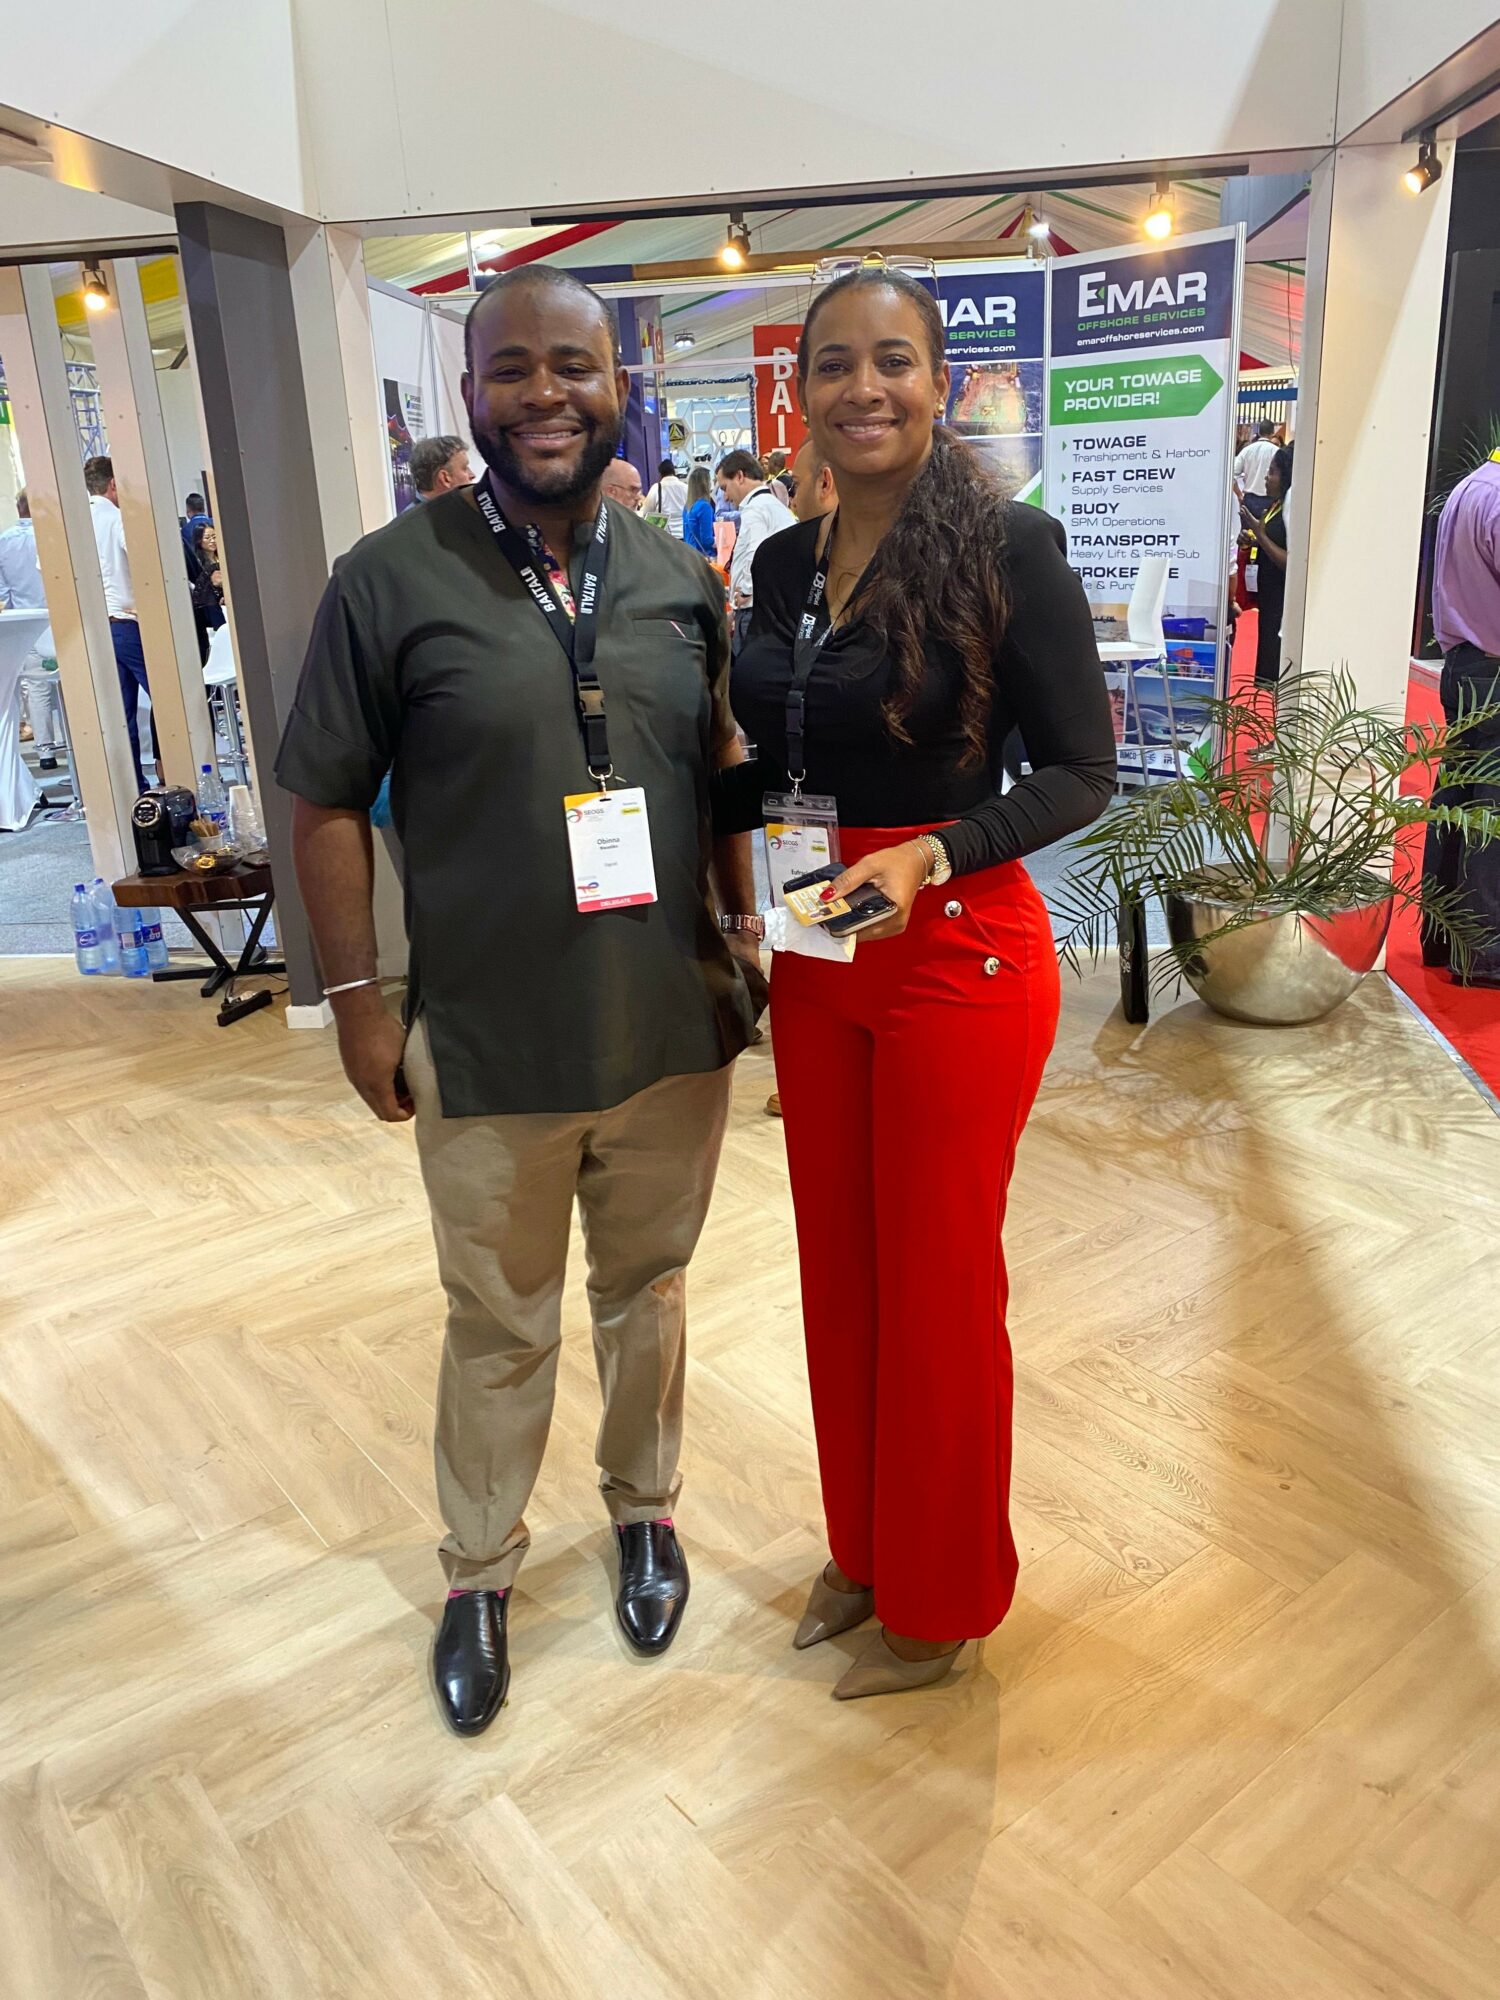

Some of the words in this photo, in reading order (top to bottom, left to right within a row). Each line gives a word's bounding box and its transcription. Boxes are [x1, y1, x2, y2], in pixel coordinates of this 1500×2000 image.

[1078, 271, 1208, 318] EMAR
[936, 295, 1017, 328] AR
[1077, 316, 1140, 331] OFFSHORE
[1143, 307, 1206, 323] SERVICES
[949, 329, 1016, 340] SERVICES
[1077, 325, 1205, 346] emaroffshoreservices.com
[944, 344, 1016, 355] services.com
[1064, 377, 1114, 394] YOUR
[1120, 369, 1202, 388] TOWAGE
[770, 347, 793, 455] BAI
[1064, 392, 1160, 411] PROVIDER!
[1073, 435, 1147, 450] TOWAGE
[1073, 452, 1148, 463] Transhipment
[1151, 450, 1161, 459] &
[1166, 448, 1211, 459] Harbor
[1072, 470, 1117, 483] FAST
[1123, 468, 1176, 481] CREW
[1071, 485, 1109, 496] Supply
[1113, 484, 1164, 494] Services
[1072, 503, 1120, 515] BUOY
[1071, 517, 1099, 527] SPM
[1102, 517, 1166, 527] Operations
[1071, 535, 1180, 546] TRANSPORT
[1071, 550, 1104, 560] Heavy
[1107, 549, 1127, 558] Lift
[1130, 549, 1140, 558] &
[1144, 549, 1200, 559] Semi-Sub
[1096, 581, 1105, 590] &
